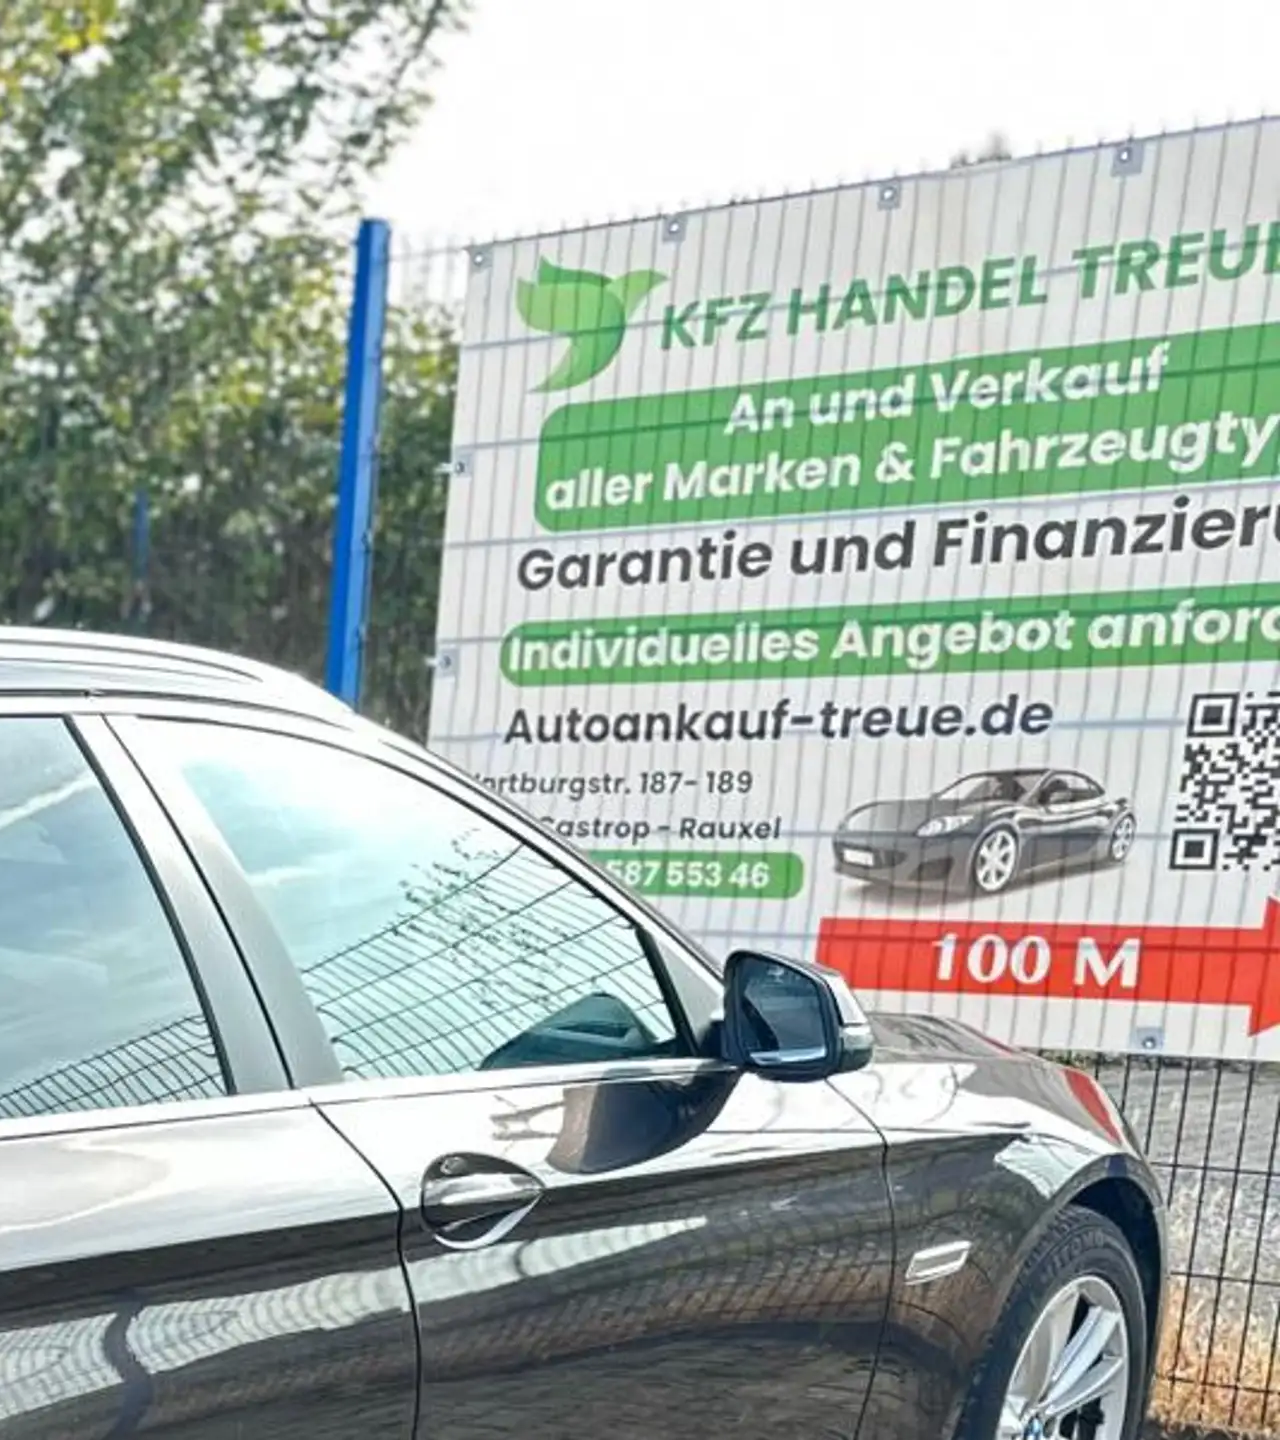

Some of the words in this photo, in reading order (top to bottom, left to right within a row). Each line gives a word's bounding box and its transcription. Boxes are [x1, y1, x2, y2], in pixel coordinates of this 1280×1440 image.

[661, 291, 772, 351] KFZ
[787, 254, 1048, 336] HANDEL
[724, 392, 794, 435] An
[810, 374, 916, 425] und
[930, 342, 1171, 414] Verkauf
[546, 467, 653, 511] aller
[663, 452, 860, 502] Marken
[875, 441, 915, 484] &
[517, 529, 772, 591] Garantie
[790, 520, 916, 576] und
[933, 495, 1280, 568] Finanzier
[509, 622, 820, 673] Individuelles
[830, 610, 1076, 671] Angebot
[504, 694, 1053, 744] Autoankauf-treue.de
[474, 771, 631, 802] artburgstr.
[706, 770, 753, 794] 189
[680, 815, 782, 840] Rauxel
[666, 860, 723, 888] 553
[728, 861, 771, 889] 46
[932, 932, 1051, 984] 100
[1074, 937, 1141, 989] M
